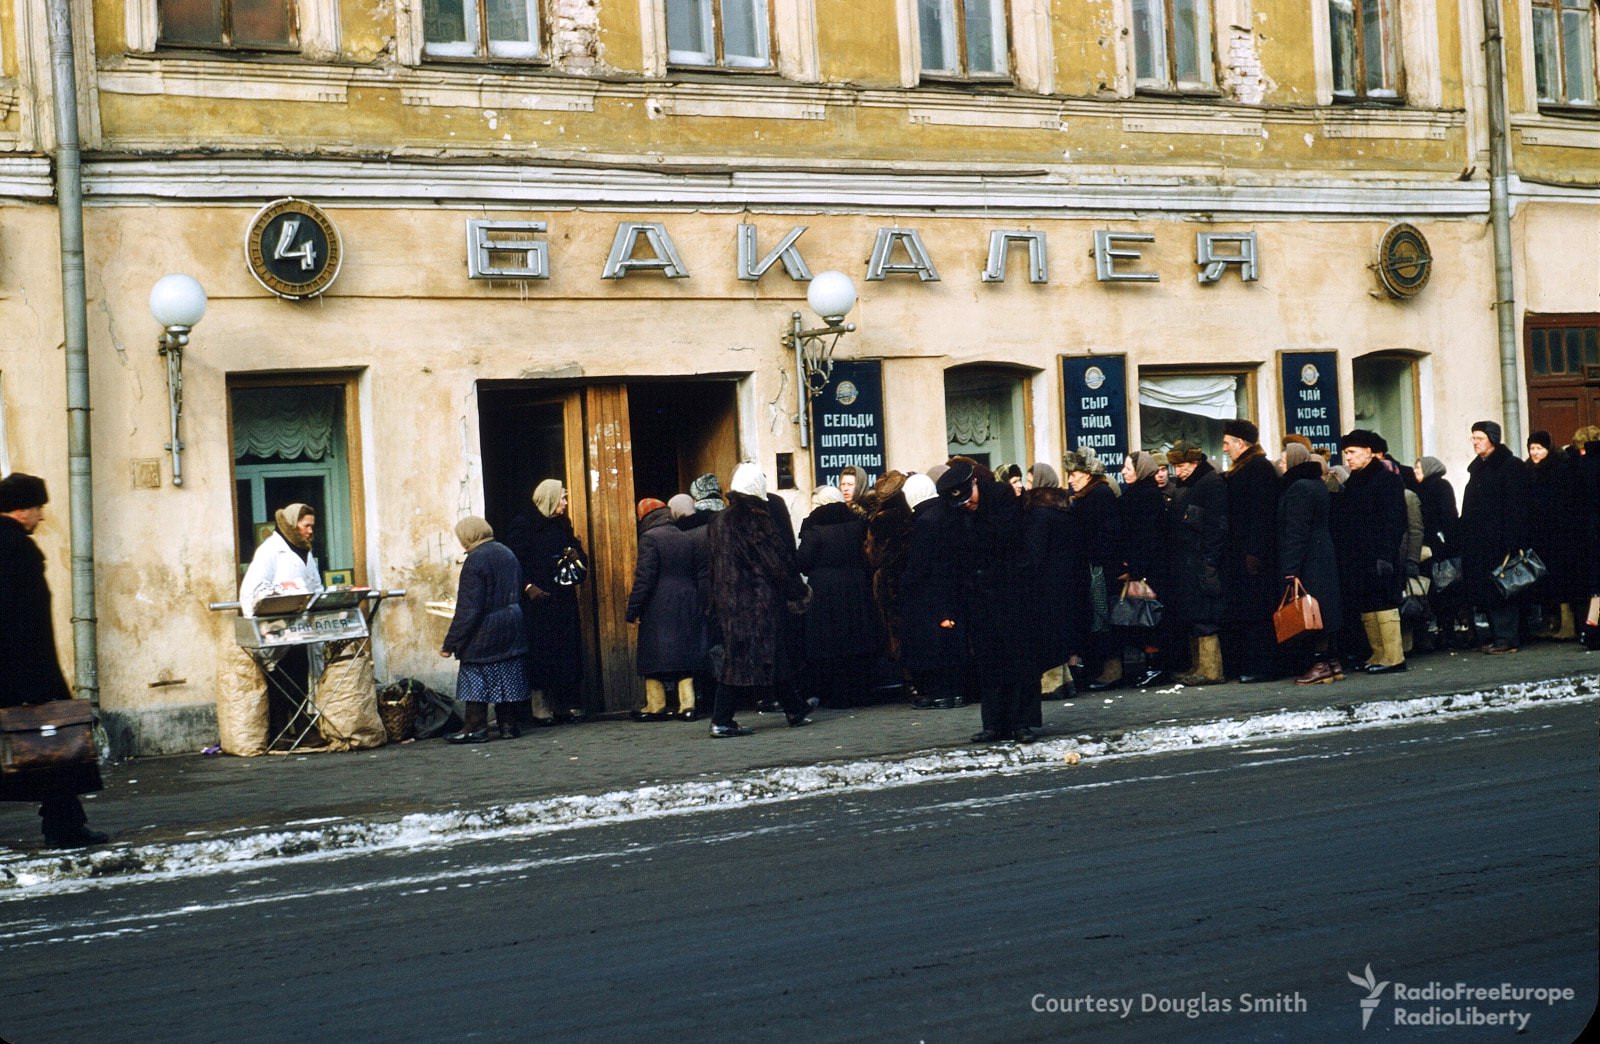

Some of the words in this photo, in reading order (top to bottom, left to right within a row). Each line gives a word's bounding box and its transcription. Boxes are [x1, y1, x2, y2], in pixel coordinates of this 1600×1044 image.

[274, 220, 317, 270] 4
[466, 218, 1258, 284] БАКАЛЕЯ
[1299, 388, 1321, 402] ЧАЙ
[1081, 396, 1109, 410] СЫР
[1297, 406, 1327, 419] КОФЕ
[824, 413, 874, 428] СЕЛЬДИ
[1081, 413, 1112, 430] ЯЙЦА
[1295, 424, 1330, 437] КАКАО
[821, 433, 877, 447] ШПРОТЫ
[1077, 433, 1116, 447] МАСЛО
